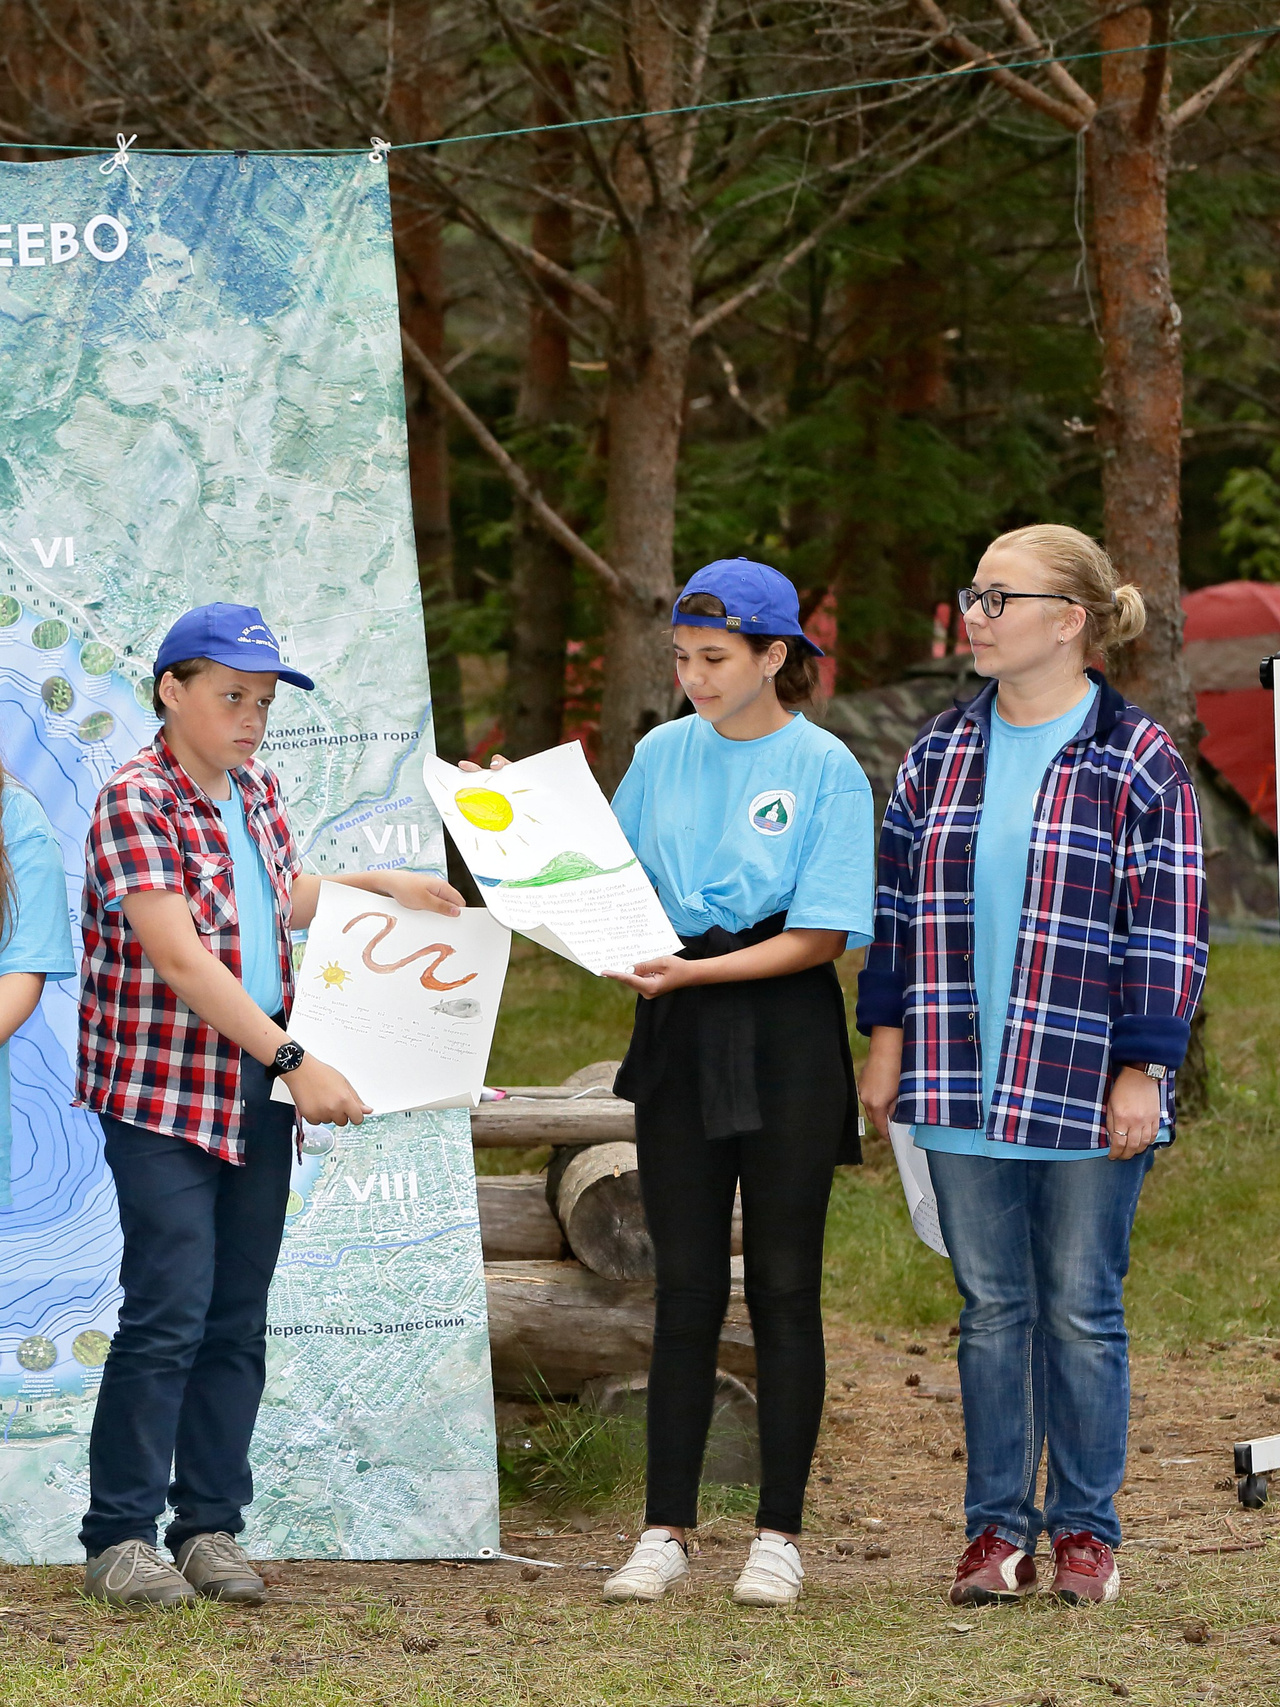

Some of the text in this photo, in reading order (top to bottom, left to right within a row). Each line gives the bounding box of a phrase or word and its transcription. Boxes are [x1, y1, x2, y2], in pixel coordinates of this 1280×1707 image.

[31, 537, 75, 568] VI
[260, 730, 420, 752] Александрова гора
[267, 724, 326, 739] камень
[333, 795, 414, 833] Малая Слуда
[362, 824, 421, 854] VII
[366, 856, 408, 871] Слуда
[344, 1171, 419, 1201] VIII
[284, 1250, 332, 1261] Трубеж
